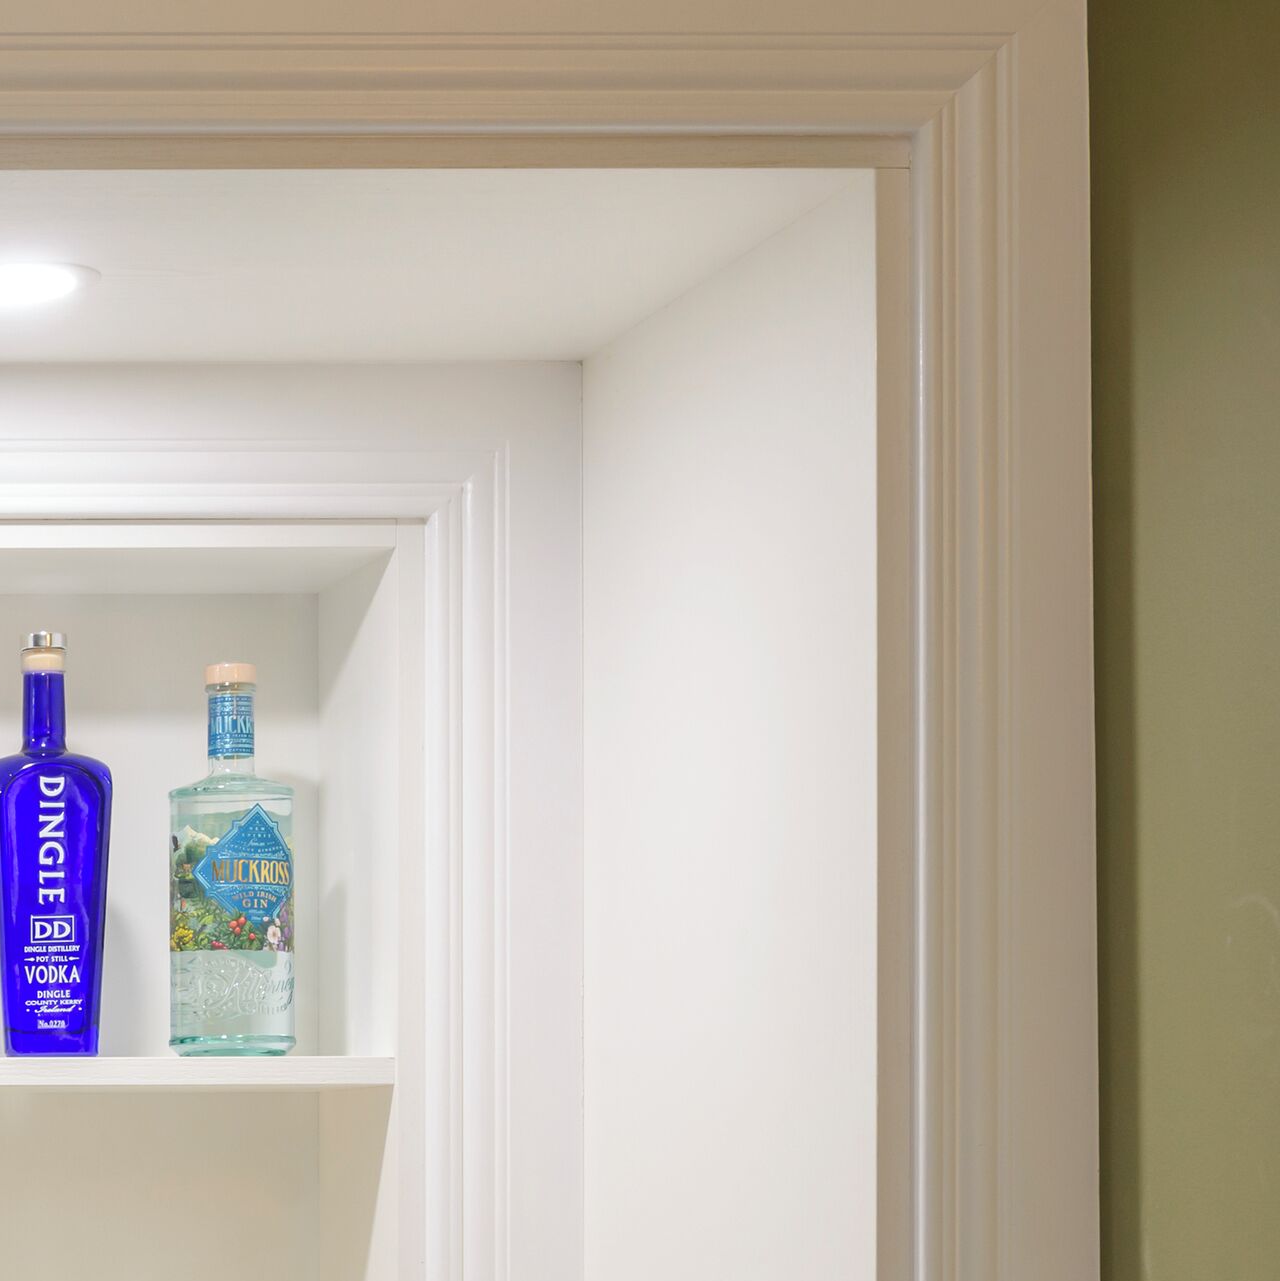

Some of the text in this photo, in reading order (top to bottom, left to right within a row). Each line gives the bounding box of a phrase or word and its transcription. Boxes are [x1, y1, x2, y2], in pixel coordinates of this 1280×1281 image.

[39, 776, 66, 905] DINGLE
[212, 859, 290, 885] MUCKROSS
[243, 899, 268, 908] GIN
[257, 891, 277, 902] IRISH
[34, 921, 72, 940] DD
[25, 965, 81, 984] VODKA
[37, 990, 71, 999] DINGLE
